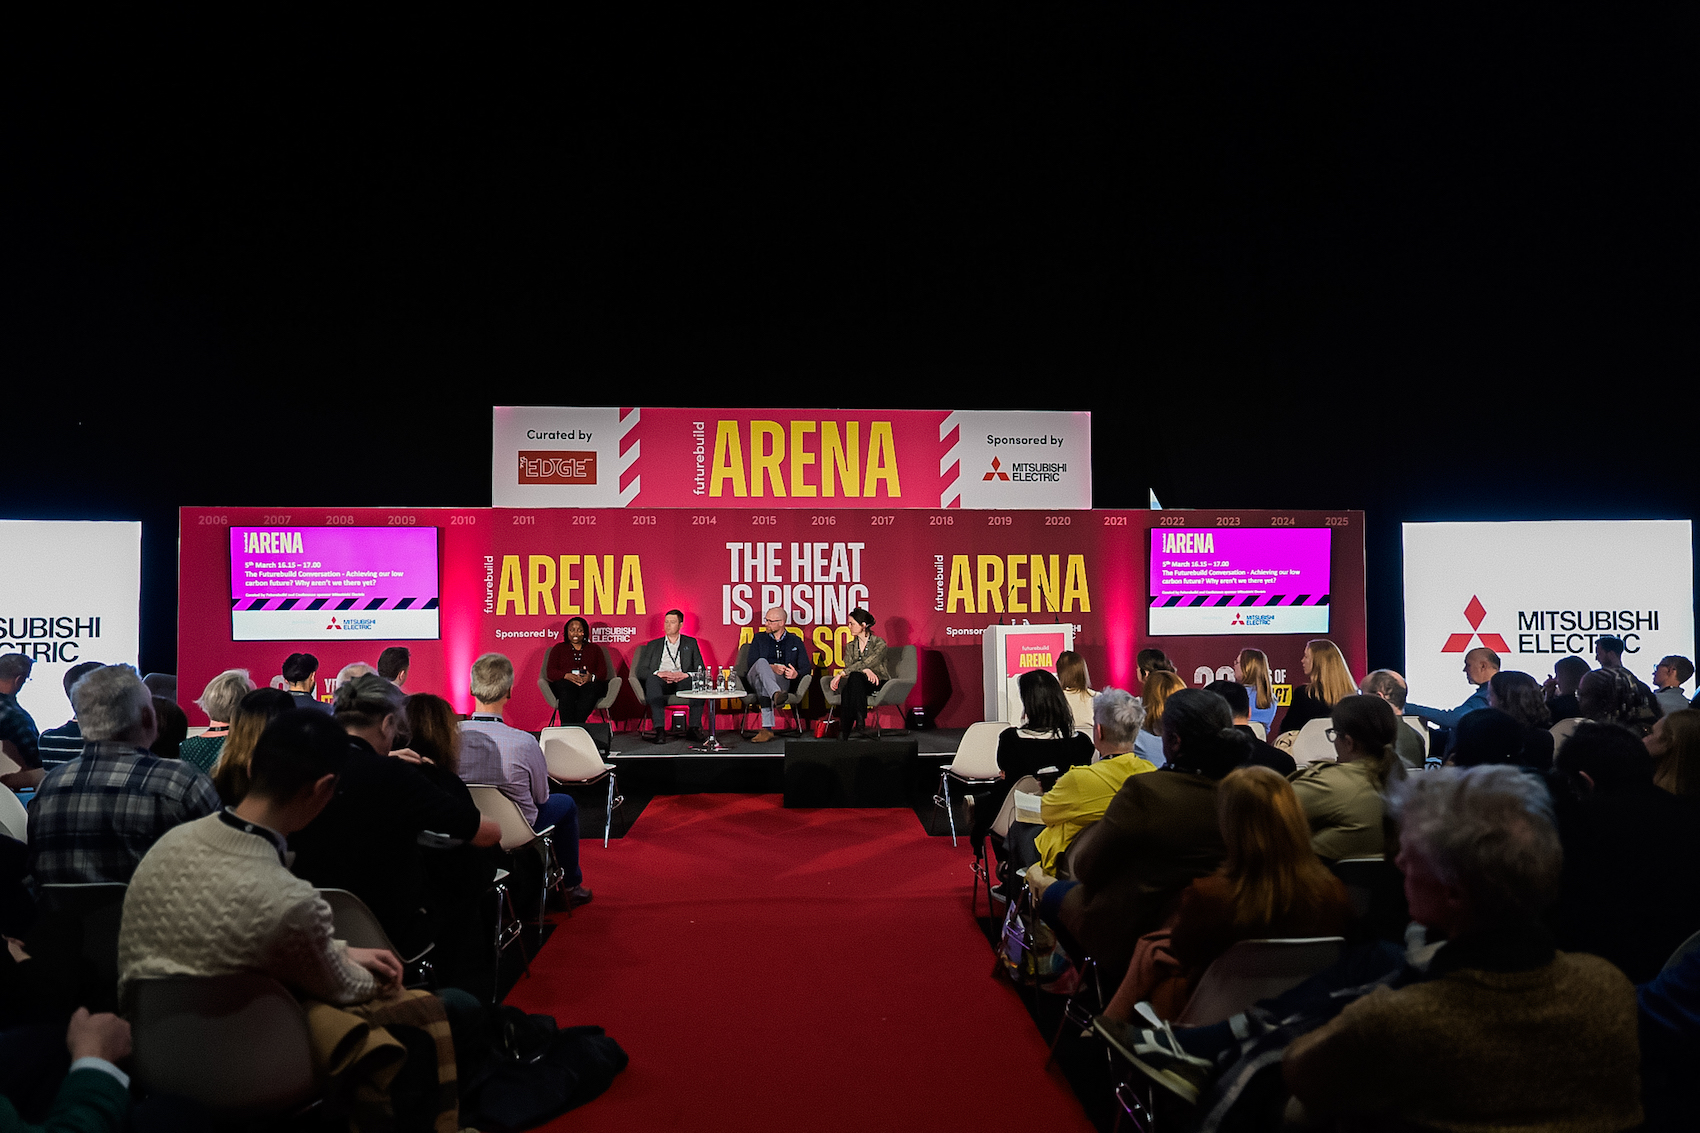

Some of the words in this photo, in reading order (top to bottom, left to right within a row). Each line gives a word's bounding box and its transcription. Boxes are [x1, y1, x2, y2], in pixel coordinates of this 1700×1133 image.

[526, 429, 575, 441] Curated
[578, 429, 593, 443] by
[986, 434, 1047, 448] Sponsored
[1050, 435, 1064, 448] by
[693, 421, 705, 496] futurebuild
[708, 420, 902, 498] ARENA
[526, 457, 594, 478] EDGE
[1012, 463, 1067, 473] MITSUBISHI
[1012, 472, 1060, 482] ELECTRIC
[198, 515, 228, 526] 2006
[263, 515, 291, 526] 2007
[325, 515, 354, 526] 2008
[387, 515, 416, 526] 2009
[450, 515, 476, 526] 2010
[512, 515, 535, 525] 2011
[572, 515, 597, 525] 2012
[632, 515, 657, 525] 2013
[692, 515, 717, 525] 2014
[752, 515, 777, 525] 2015
[811, 516, 836, 526] 2016
[871, 516, 895, 526] 2017
[930, 516, 954, 526] 2018
[988, 516, 1012, 526] 2019
[1045, 516, 1071, 526] 2020
[1103, 517, 1127, 526] 2021
[1160, 517, 1185, 526] 2022
[1216, 517, 1241, 526] 2023
[1271, 517, 1295, 526] 2024
[1325, 517, 1349, 526] 2025
[249, 532, 304, 553] ARENA
[1165, 532, 1215, 554] ARENA
[255, 561, 276, 569] March
[277, 561, 296, 569] 16.15
[303, 561, 321, 569] 17.00
[725, 542, 783, 583] THE
[790, 542, 865, 583] HEAT
[1213, 560, 1230, 568] 17.00
[346, 570, 378, 579] Achieving
[1250, 569, 1278, 577] Achieving
[245, 579, 268, 587] carbon
[269, 579, 294, 587] future?
[295, 579, 310, 588] Why
[343, 579, 362, 587] there
[362, 579, 377, 588] yet?
[484, 555, 494, 614] futurebuild
[495, 554, 647, 616] ARENA
[934, 555, 944, 612] futurebuild
[946, 554, 1091, 614] ARENA
[1162, 577, 1182, 585] carbon
[1183, 577, 1205, 585] future?
[1205, 577, 1219, 586] Why
[1264, 577, 1277, 585] yet?
[722, 584, 753, 626] IS
[1518, 610, 1659, 632] MITSUBISHI
[495, 629, 546, 640] Sponsored
[547, 629, 560, 640] by
[591, 627, 636, 635] MITSUBISHI
[946, 627, 987, 637] Sponsor
[591, 635, 631, 643] ELECTRIC
[1518, 633, 1641, 655] ELECTC
[1019, 653, 1053, 668] ARENA
[1274, 668, 1287, 684] OF
